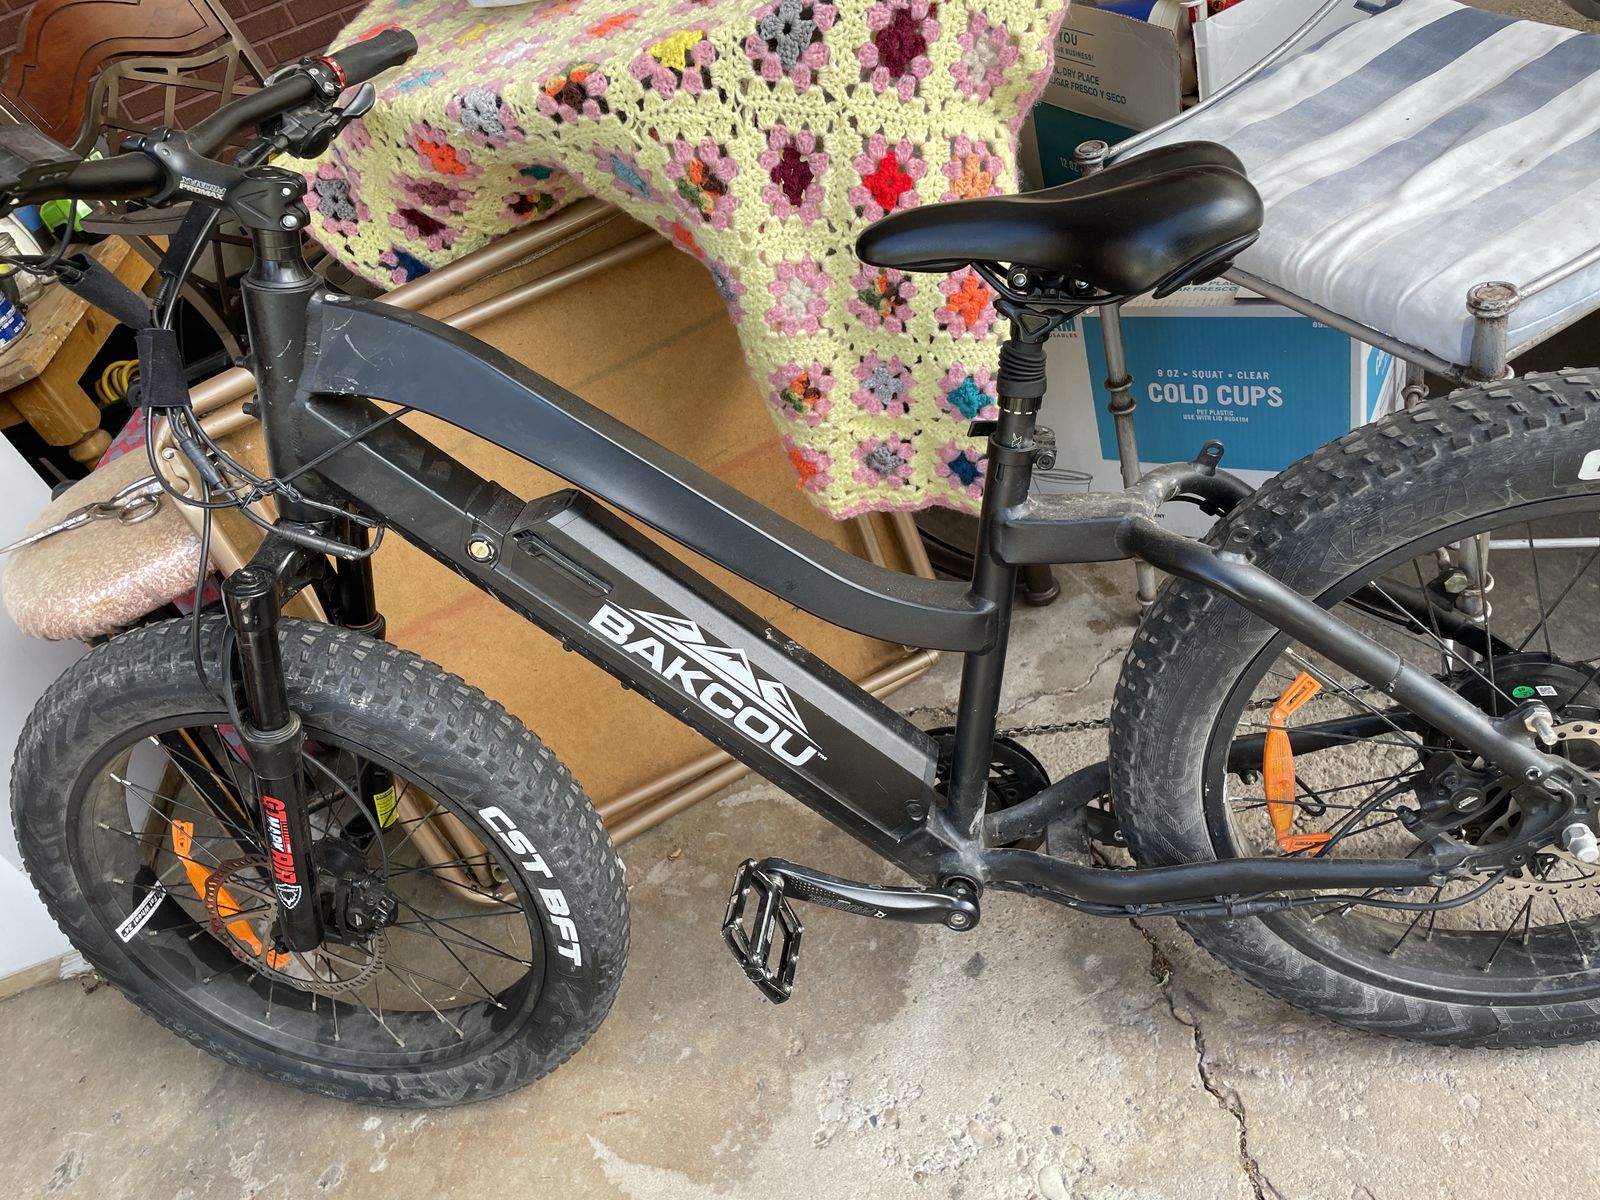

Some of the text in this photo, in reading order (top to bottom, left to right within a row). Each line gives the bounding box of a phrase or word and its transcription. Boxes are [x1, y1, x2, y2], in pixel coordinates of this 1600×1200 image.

[1058, 31, 1078, 46] YOU
[1062, 67, 1077, 79] DRY
[1077, 71, 1100, 86] PLACE
[1071, 82, 1098, 97] FRESCO
[1099, 89, 1105, 99] Y
[1106, 91, 1127, 105] SECO
[179, 182, 224, 201] PROMAX
[1157, 369, 1270, 380] 9 OZ SQUAT CLEAR
[1147, 382, 1284, 408] COLD CUPS
[1209, 409, 1234, 417] PLASTIC
[588, 603, 817, 766] BAKCOU
[478, 805, 583, 967] CST BFT
